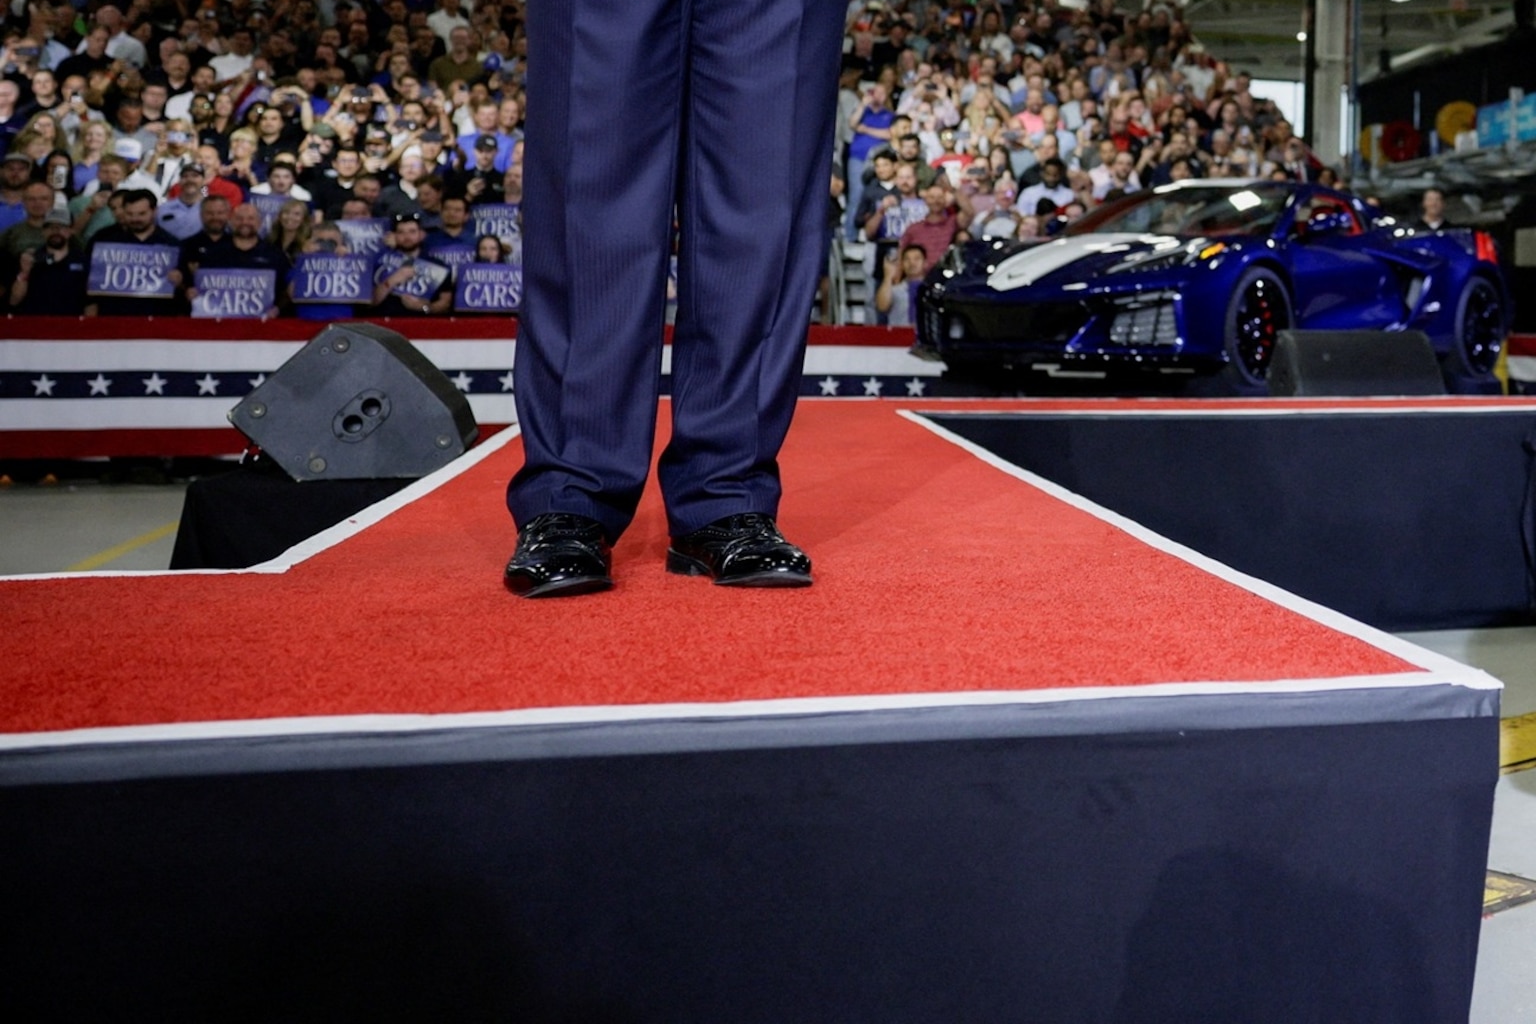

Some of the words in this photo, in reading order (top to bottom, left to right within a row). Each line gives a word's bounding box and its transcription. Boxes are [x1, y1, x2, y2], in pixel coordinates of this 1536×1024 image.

[100, 248, 171, 267] AMERICAN
[301, 257, 367, 273] AMERICAN
[100, 264, 163, 291] JOBS
[200, 275, 268, 289] AMERICAN
[303, 271, 360, 298] JOBS
[202, 288, 265, 315] CARS
[464, 283, 522, 307] CARS
